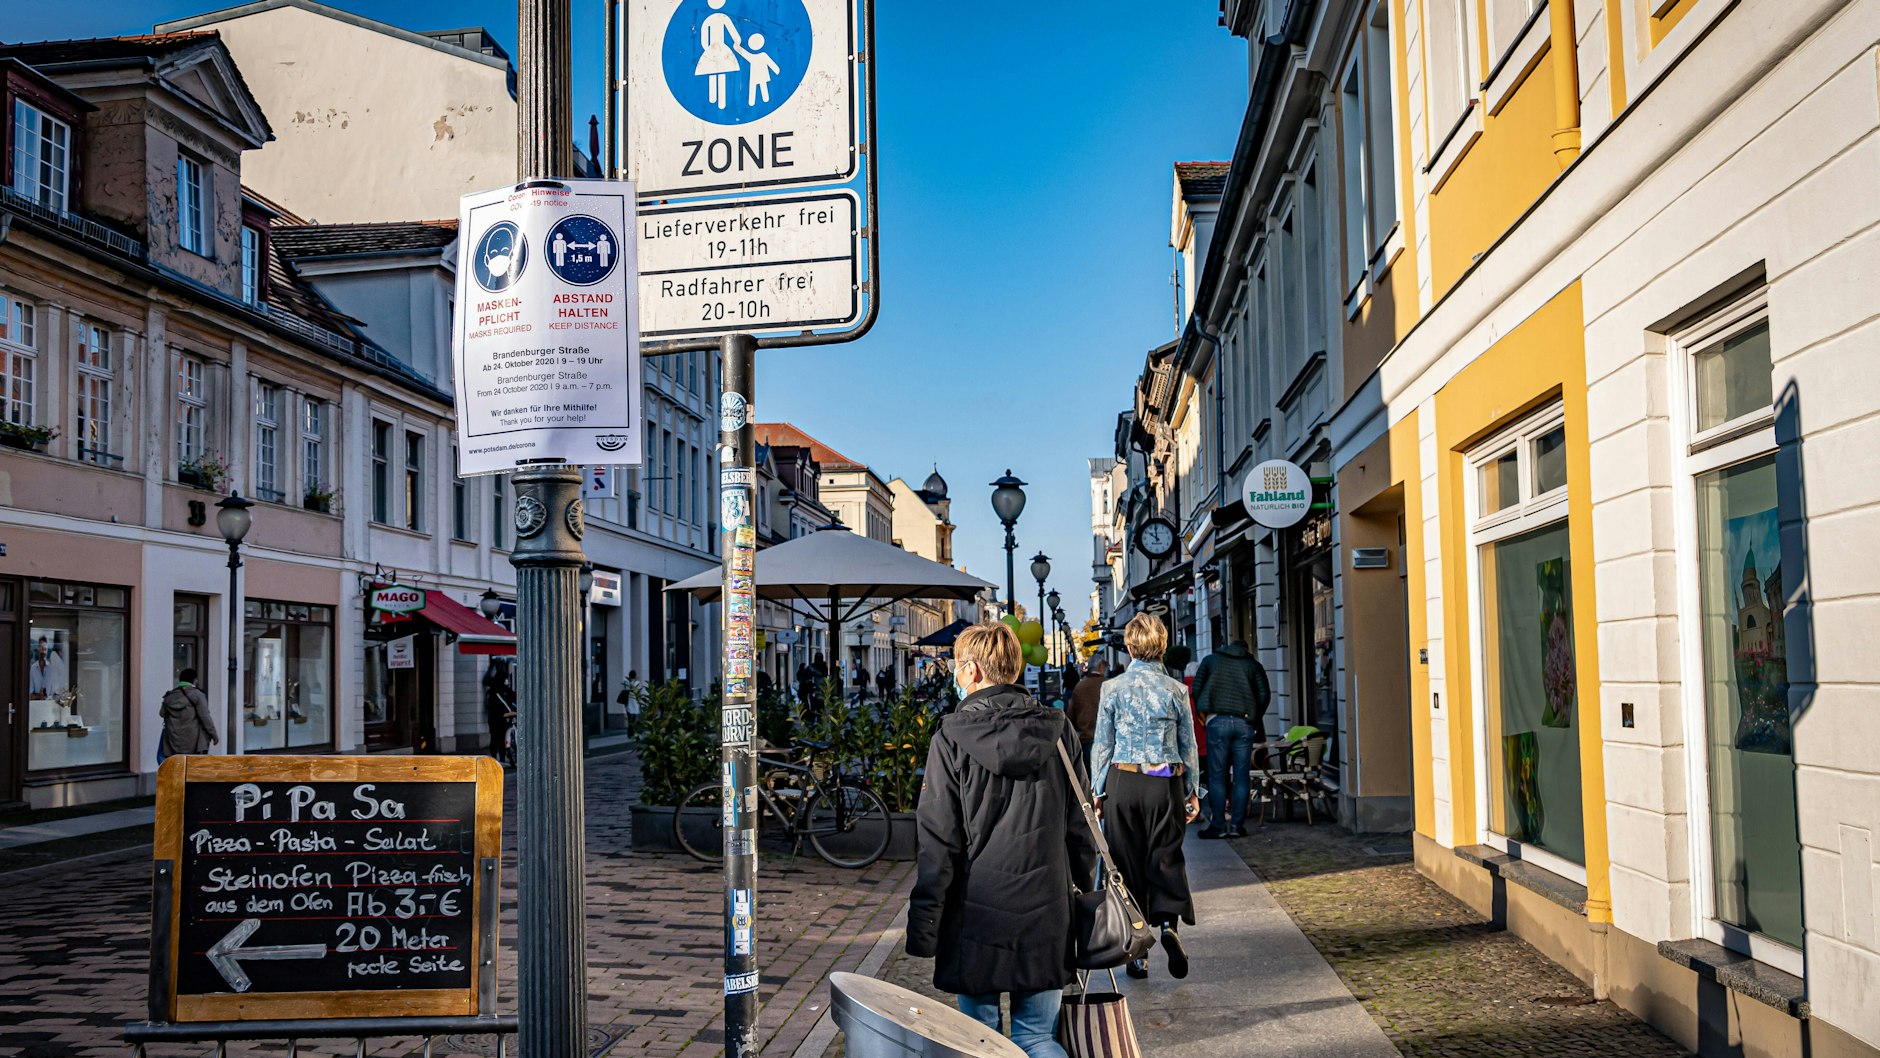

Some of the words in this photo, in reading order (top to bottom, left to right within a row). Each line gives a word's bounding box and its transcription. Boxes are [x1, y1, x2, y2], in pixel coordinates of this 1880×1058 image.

[681, 131, 794, 177] ZONE
[644, 212, 785, 240] Lieferverkehr
[799, 206, 835, 227] frei
[707, 238, 768, 259] 19-11h
[661, 276, 765, 298] Radfahrer
[778, 271, 814, 291] frei
[477, 297, 522, 313] MASKEN-
[553, 293, 613, 304] ABSTAND
[479, 311, 521, 326] PFLICHT
[558, 307, 608, 318] HALTEN
[701, 300, 771, 321] 20-10h
[469, 329, 492, 340] MASKS
[494, 324, 532, 336] REQUIRED
[548, 322, 573, 330] KEEP
[574, 321, 618, 330] DISTANCE
[492, 347, 556, 361] Brandenburger
[558, 346, 590, 355] Straße
[482, 363, 492, 372] Ab
[493, 362, 503, 371] 24.
[504, 359, 534, 370] Oktober
[535, 357, 555, 366] 2020
[561, 357, 567, 365] 9
[576, 357, 586, 365] 19
[588, 356, 604, 365] Uhr
[497, 373, 555, 385] Brandenburger
[558, 371, 588, 381] Straße
[476, 389, 493, 399] From
[493, 388, 502, 396] 24
[502, 385, 529, 395] October
[529, 383, 549, 392] 2020
[555, 383, 561, 391] 9
[588, 383, 594, 391] 7
[490, 408, 502, 418] Wir
[503, 406, 528, 417] danken
[529, 404, 542, 413] für
[543, 404, 561, 413] Ihre
[563, 403, 598, 412] Mithilfe!
[499, 418, 519, 427] Thank
[520, 417, 532, 426] you
[534, 415, 544, 423] for
[546, 416, 565, 426] your
[566, 414, 587, 424] help!
[1249, 490, 1305, 502] Fahland
[376, 592, 419, 602] MAGO
[189, 829, 252, 855] Pizza
[270, 828, 338, 853] Pasta
[363, 827, 437, 851] Salat
[201, 864, 333, 892] Steinofen
[345, 861, 418, 888] Pizza
[205, 899, 238, 913] aus
[246, 896, 284, 913] dem
[290, 892, 333, 911] Ofen
[347, 891, 387, 917] Ab
[439, 888, 462, 917] €
[335, 922, 381, 953] 20
[391, 926, 450, 950] Meter
[408, 955, 466, 974] Seite
